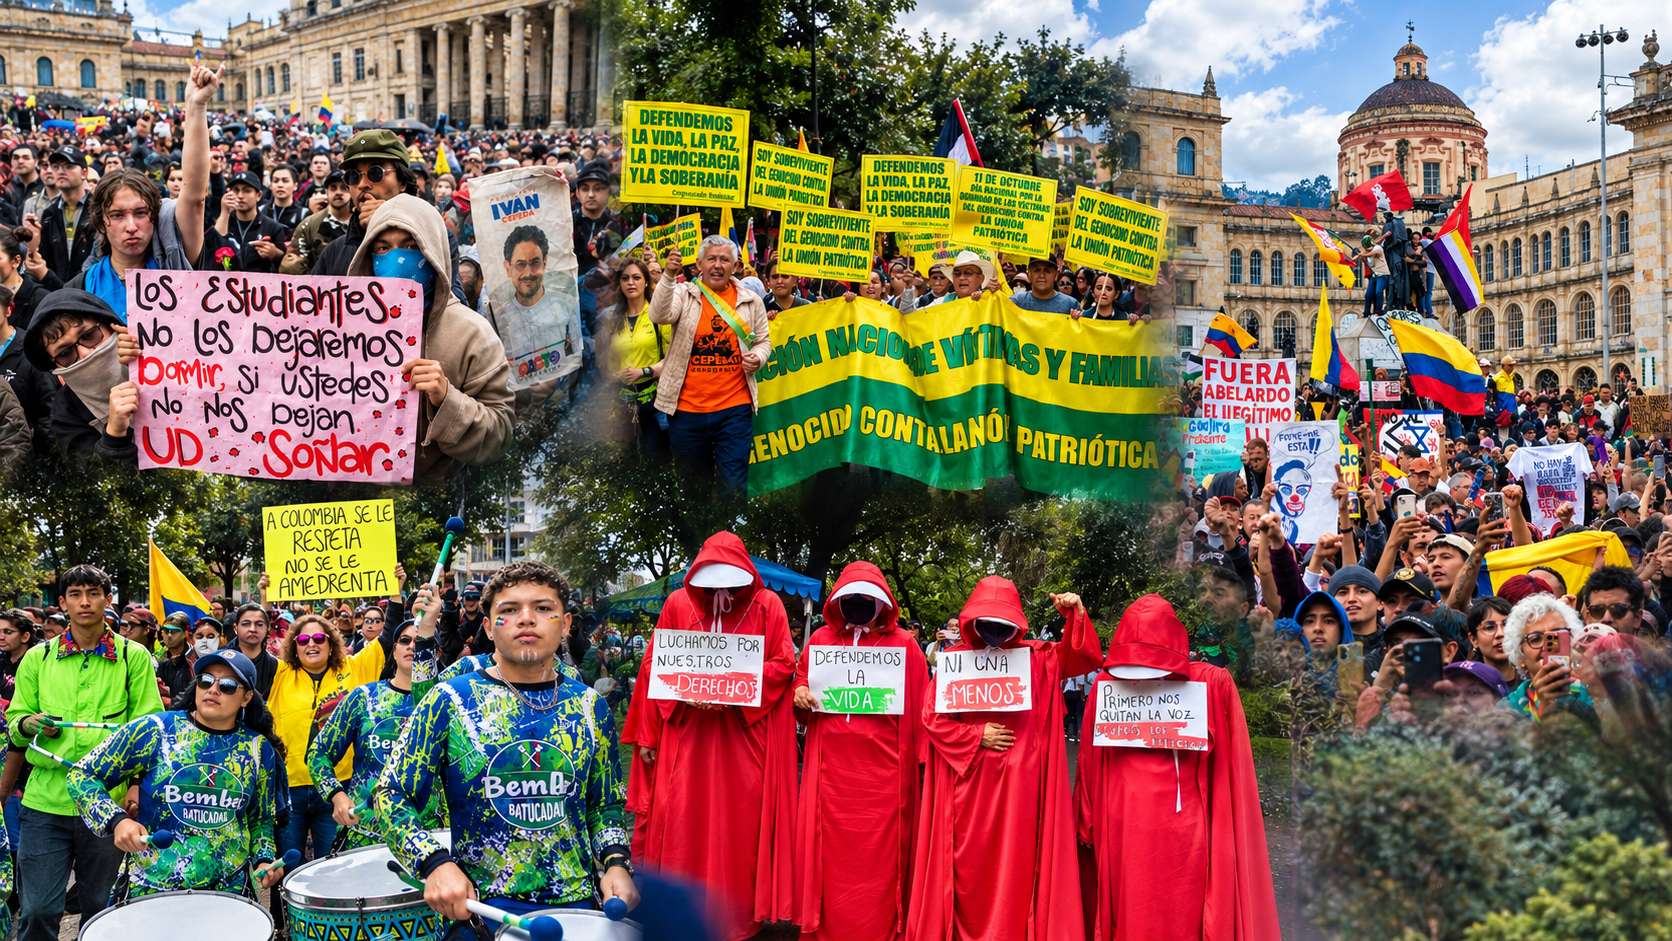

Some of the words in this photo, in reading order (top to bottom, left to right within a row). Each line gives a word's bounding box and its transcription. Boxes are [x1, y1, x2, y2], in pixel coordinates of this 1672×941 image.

[640, 109, 732, 132] DEFENDEMOS
[632, 129, 648, 144] LA
[651, 130, 687, 148] VIDA,
[691, 132, 707, 148] LA
[711, 134, 740, 153] PAZ,
[631, 148, 647, 164] LA
[651, 149, 740, 170] DEMOCRACIA
[756, 148, 773, 163] SOY
[755, 165, 766, 179] DEL
[874, 160, 945, 174] DEFENDEMOS
[629, 167, 639, 183] Y
[640, 168, 656, 184] LA
[660, 169, 738, 190] SOBERANÍA
[867, 175, 879, 187] LA
[882, 176, 910, 188] VIDA,
[912, 176, 926, 188] LA
[928, 177, 950, 190] PAZ,
[985, 174, 997, 184] DE
[754, 182, 763, 196] LA
[866, 190, 878, 202] LA
[881, 190, 951, 204] DEMOCRACIA
[1035, 194, 1042, 202] LA
[491, 194, 540, 220] IVAN
[866, 205, 874, 214] Y
[890, 205, 950, 219] SOBERANÍA
[1078, 196, 1097, 214] SOY
[786, 210, 804, 226] SOY
[980, 215, 992, 225] LA
[784, 229, 797, 244] DEL
[1074, 214, 1088, 231] DEL
[1130, 230, 1158, 252] CONTRA
[1071, 233, 1082, 250] LA
[1084, 237, 1110, 256] UNIÓN
[782, 248, 793, 262] LA
[1045, 348, 1066, 380] Y
[1069, 352, 1180, 388] FAMILIAS
[1205, 358, 1291, 385] FUERA
[1204, 384, 1291, 403] ABELARDO
[1204, 404, 1218, 418] EL
[1382, 412, 1398, 424] NO
[142, 426, 204, 467] UD
[1016, 433, 1160, 470] PATRIÓTICA
[266, 512, 276, 531] A
[280, 507, 347, 528] COLOMBIA
[354, 506, 372, 524] SE
[376, 504, 393, 522] LE
[293, 527, 362, 554] RESPETA
[285, 558, 308, 574] NO
[315, 556, 333, 572] SE
[340, 554, 360, 569] LE
[279, 570, 388, 598] AMEDRENTA
[658, 633, 728, 650] LUCHAMOS
[738, 637, 760, 653] POR
[814, 650, 901, 666] DEFENDEMOS
[945, 654, 962, 673] NI
[676, 674, 756, 699] DERECHOS
[847, 669, 865, 686] LA
[828, 691, 874, 710] VIDA
[952, 682, 1014, 706] MENOS
[1158, 694, 1180, 705] NOS
[1100, 710, 1141, 722] QUITAN
[1148, 710, 1161, 720] LA
[1168, 710, 1194, 720] VOZ
